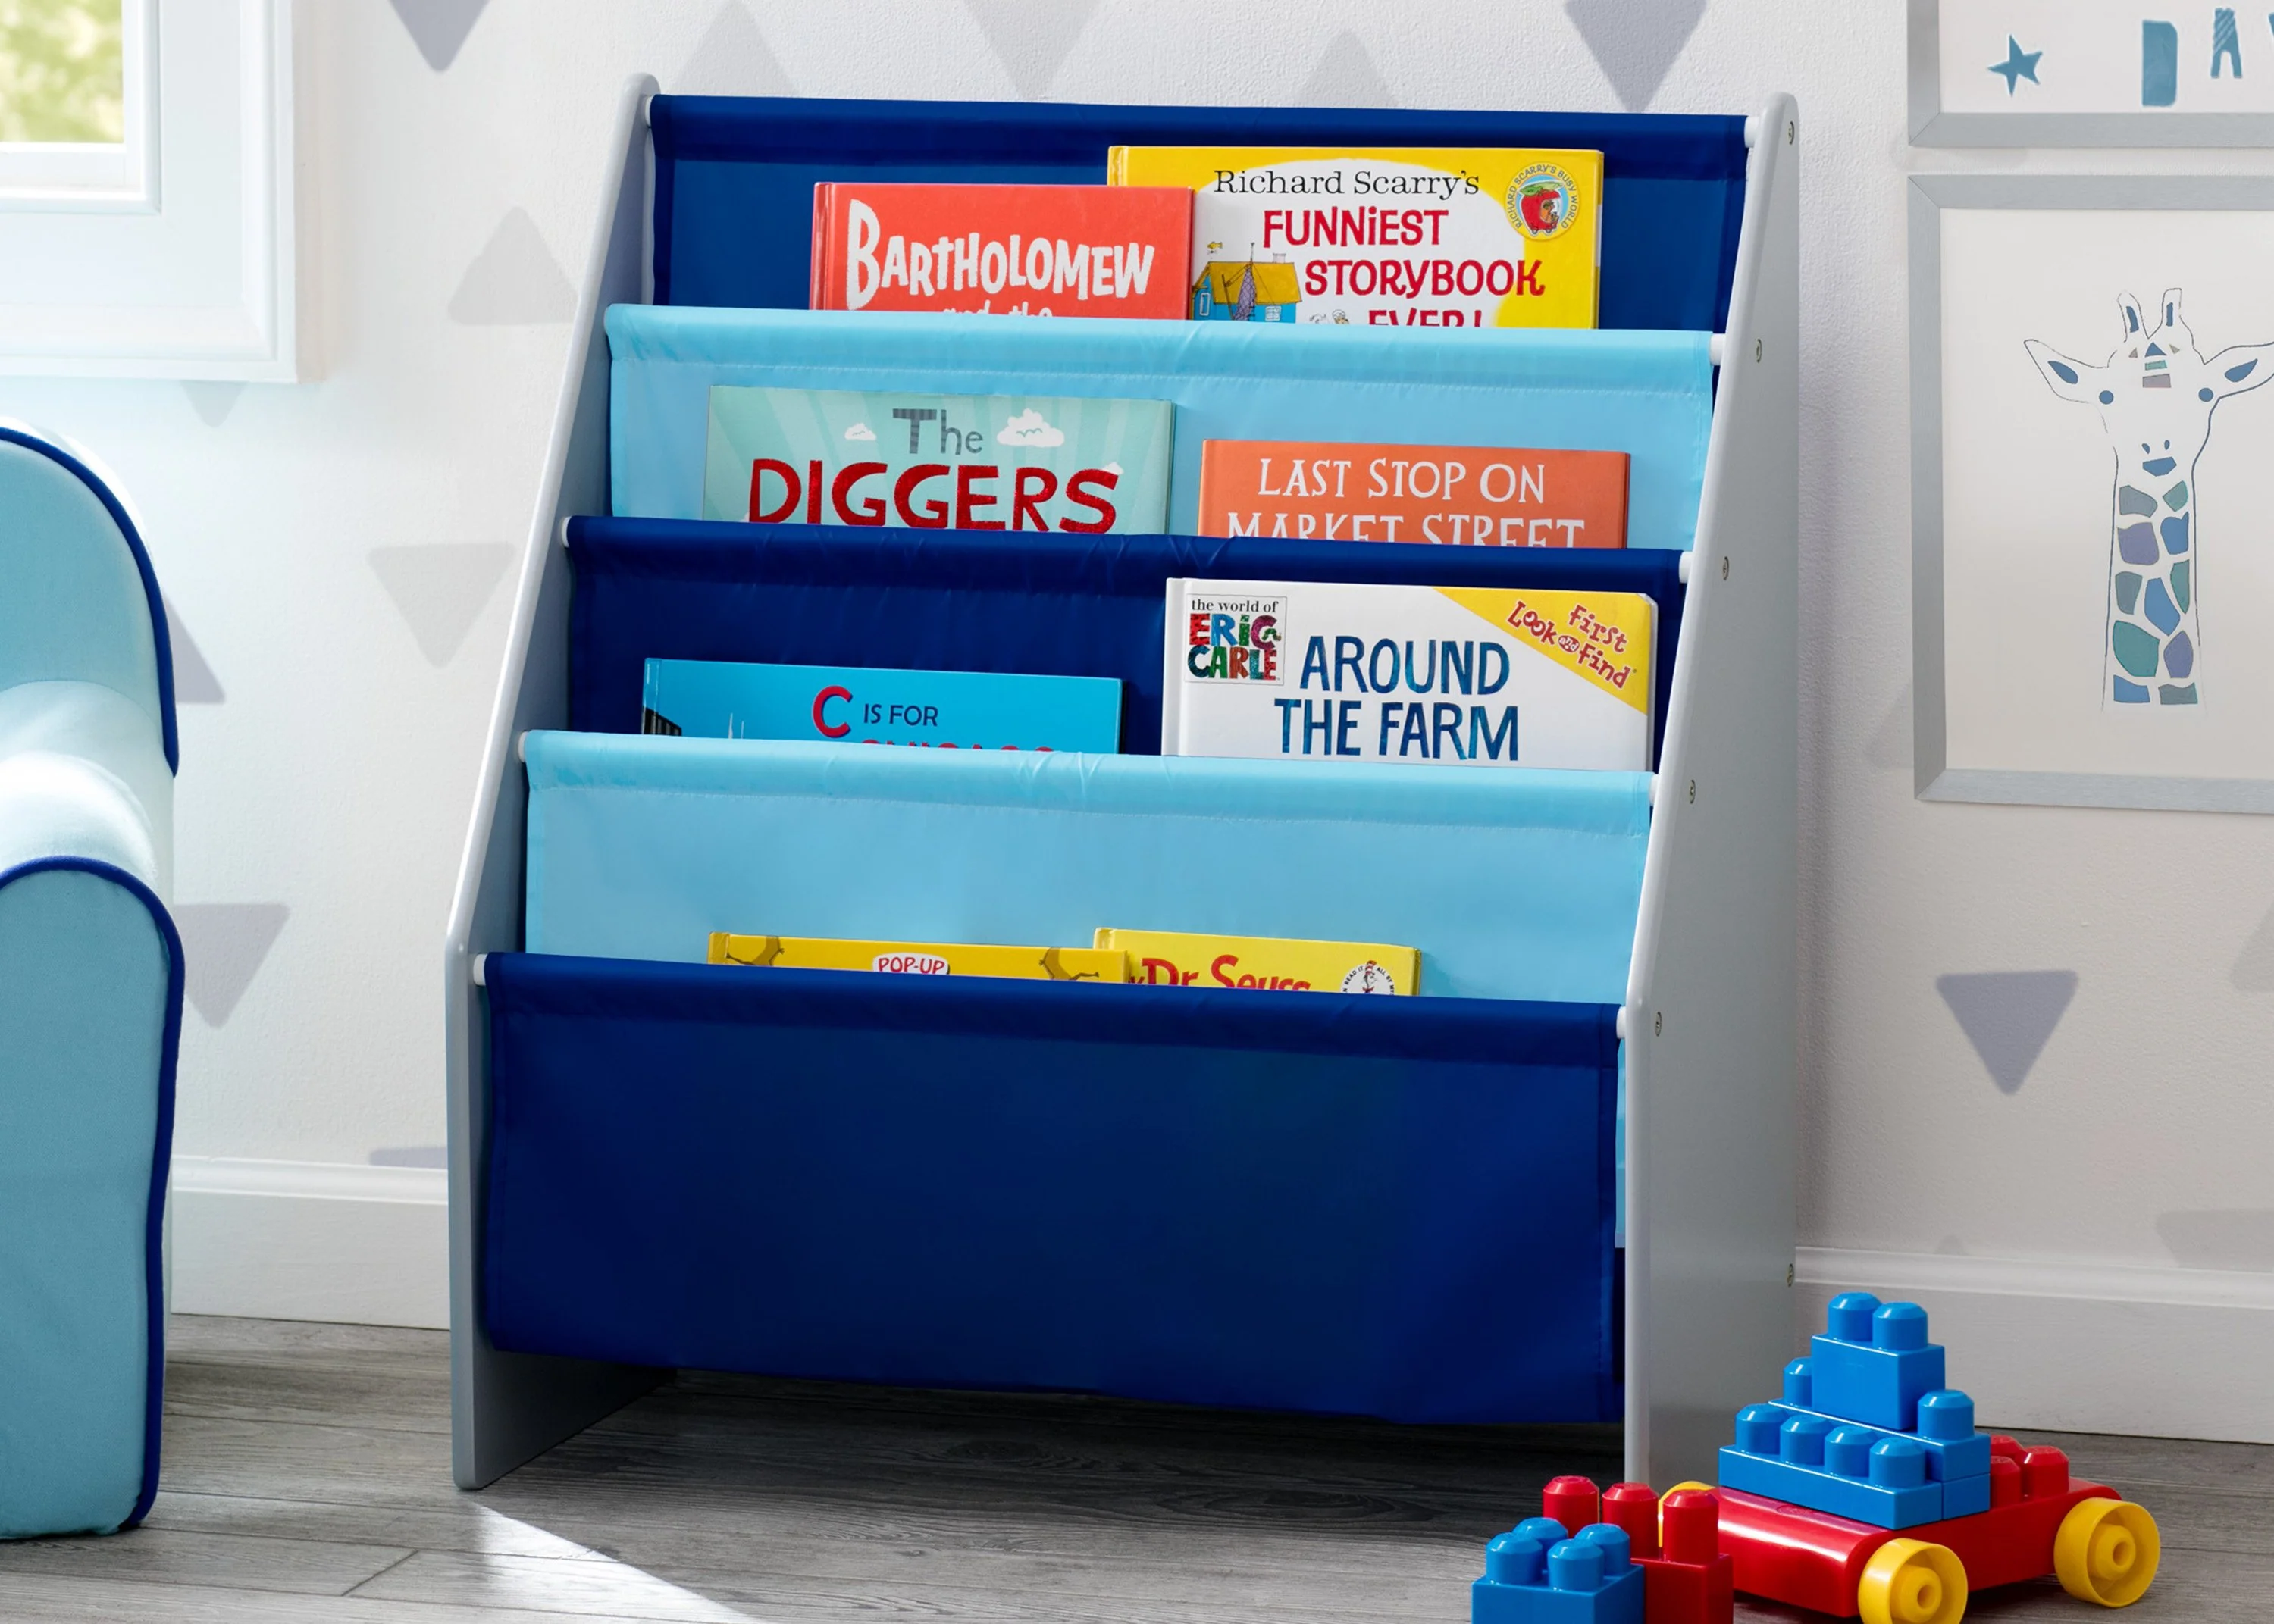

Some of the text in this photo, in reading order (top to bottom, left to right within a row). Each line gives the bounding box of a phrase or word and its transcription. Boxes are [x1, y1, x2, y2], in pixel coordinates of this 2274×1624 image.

[2142, 8, 2274, 107] DA
[1214, 169, 1480, 200] Richard Scarry's
[1507, 164, 1578, 228] RICHARD SCARRY'S BUSY WORLD
[846, 199, 1155, 311] BARTHOLOMEW
[1305, 259, 1546, 299] STORYBOOK
[891, 408, 984, 455] The
[748, 458, 1120, 534] DIGGERS
[1258, 458, 1546, 504] LAST STOP ON
[1227, 512, 1586, 549] MARKET STREET
[1191, 598, 1280, 612] the world of
[1507, 601, 1558, 646] Look
[1558, 637, 1579, 652] and
[1568, 604, 1627, 653] First
[1187, 644, 1278, 681] CARLE
[1299, 635, 1510, 695] AROUND
[812, 684, 939, 738] C IS FOR
[1274, 698, 1519, 761] THE FARM
[878, 956, 945, 975] POP-UP
[1344, 970, 1358, 985] READ
[1377, 966, 1386, 976] ALL
